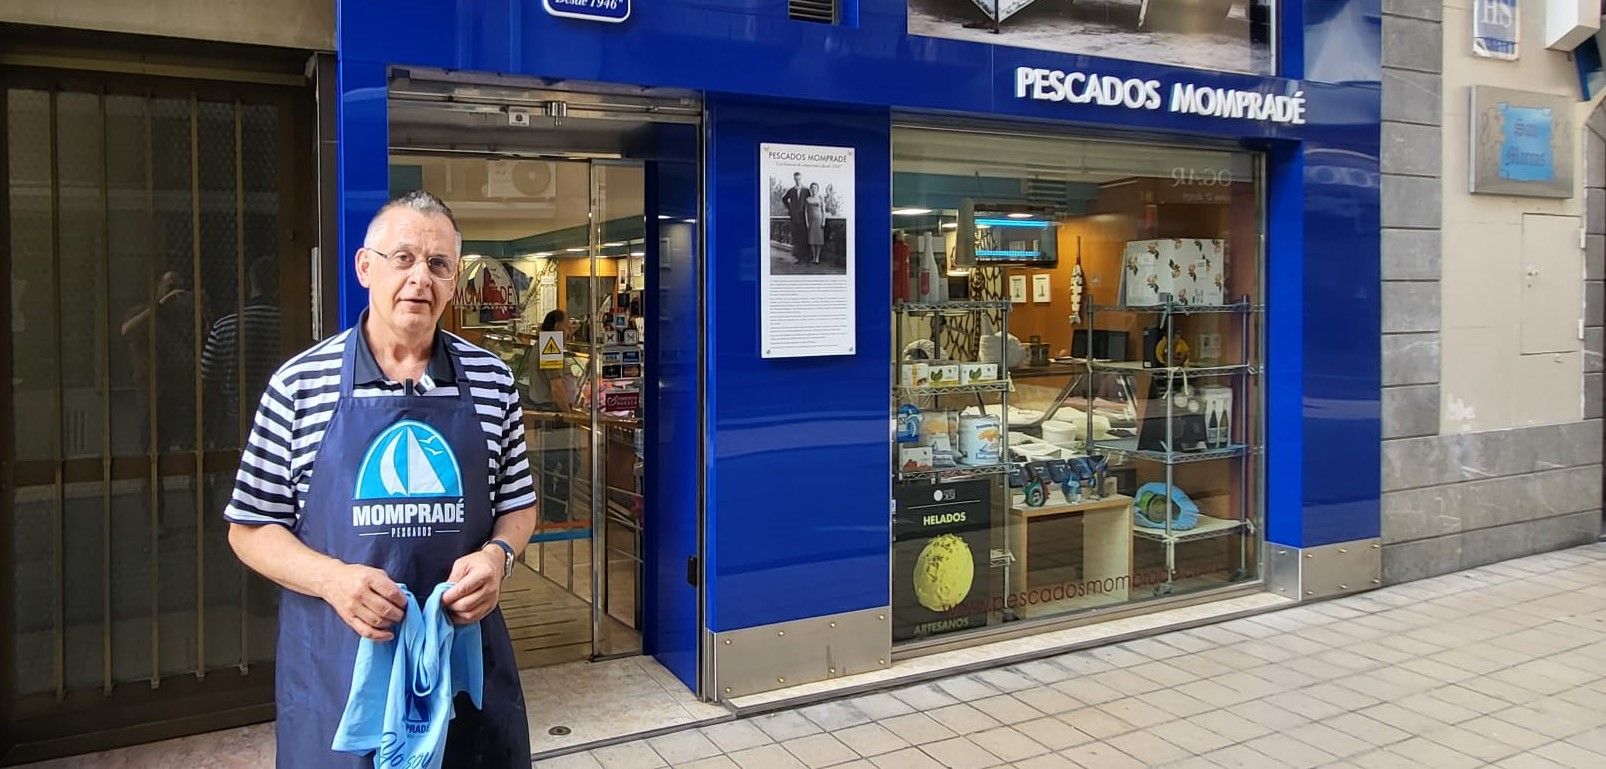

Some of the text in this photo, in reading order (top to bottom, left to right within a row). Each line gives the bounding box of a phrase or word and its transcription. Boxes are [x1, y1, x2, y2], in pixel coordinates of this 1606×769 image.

[1014, 66, 1306, 125] PESCADOS MOMPRADÉ
[768, 151, 806, 161] PESCADOS
[353, 498, 465, 526] MOMPRADÉ
[923, 511, 967, 526] HELADOS
[391, 526, 432, 538] PESCADOS
[913, 617, 969, 635] ARTESANOS
